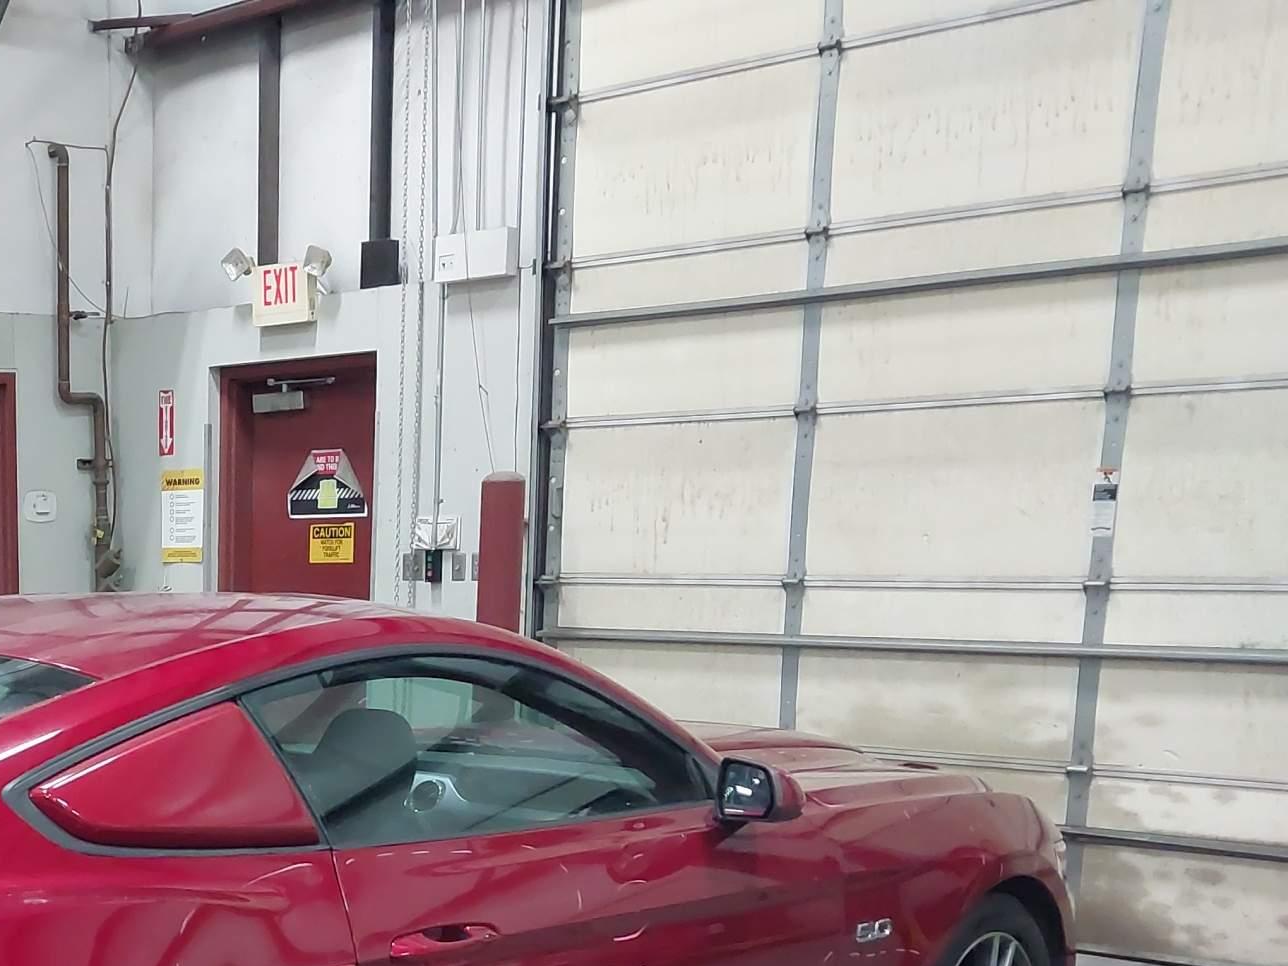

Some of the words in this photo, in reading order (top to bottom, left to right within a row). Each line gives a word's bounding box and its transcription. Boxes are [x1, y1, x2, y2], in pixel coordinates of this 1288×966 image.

[263, 266, 297, 306] EXIT
[165, 476, 200, 487] WARNING
[313, 527, 351, 538] CAUTION
